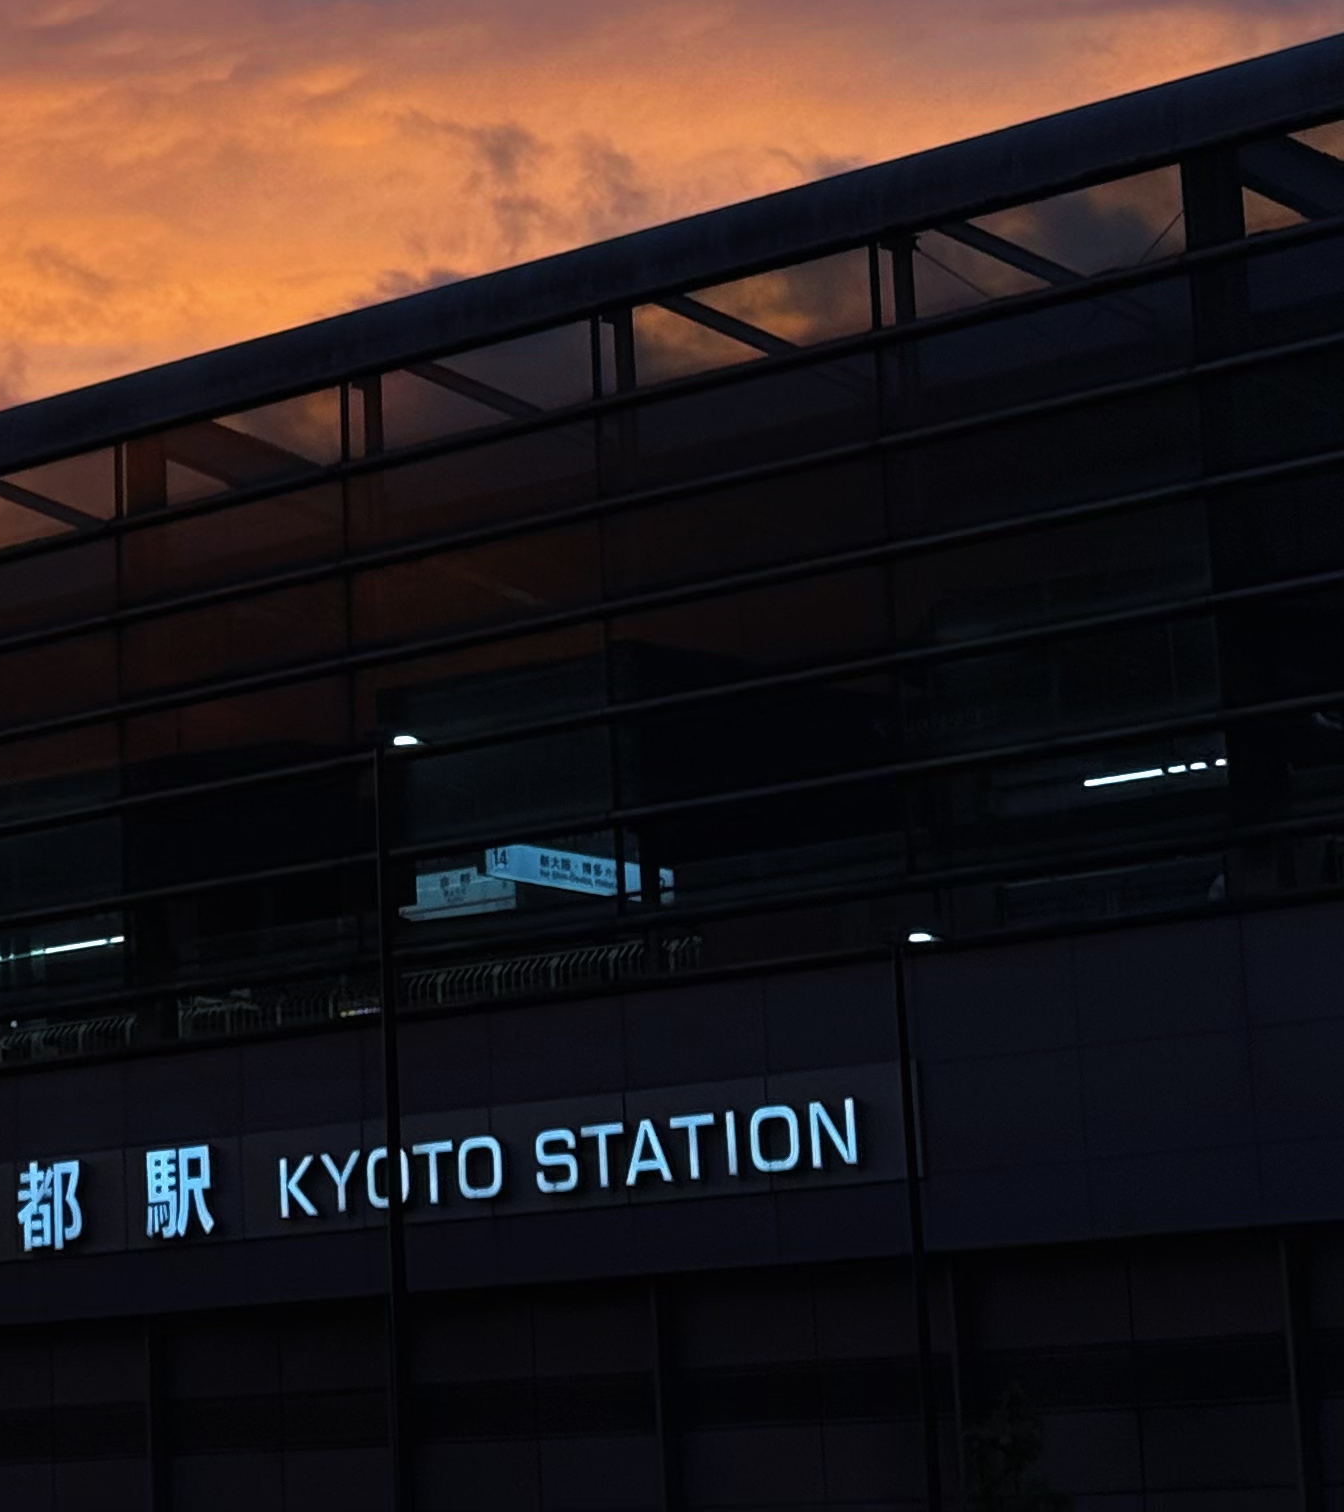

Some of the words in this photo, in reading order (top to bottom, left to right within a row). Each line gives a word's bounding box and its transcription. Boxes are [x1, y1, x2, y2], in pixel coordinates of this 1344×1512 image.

[492, 847, 508, 867] 14
[278, 1134, 504, 1219] KYOTO
[535, 1096, 859, 1194] STATION
